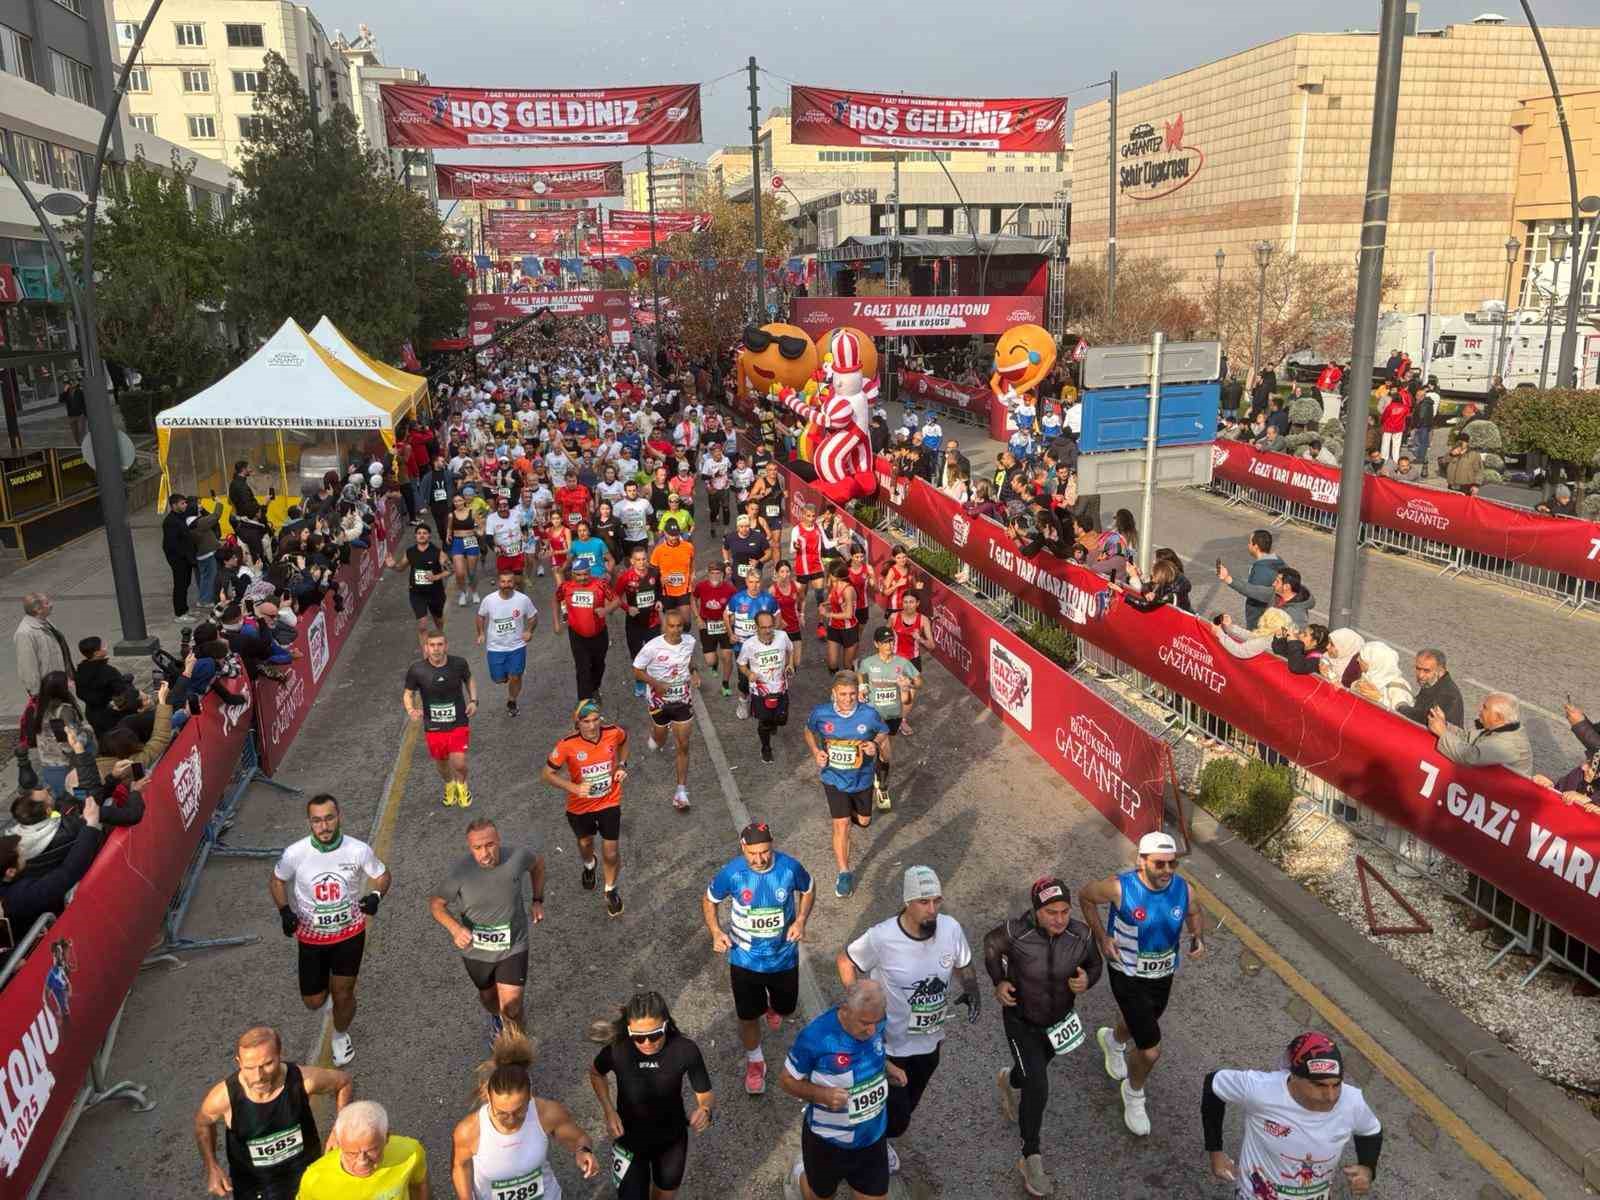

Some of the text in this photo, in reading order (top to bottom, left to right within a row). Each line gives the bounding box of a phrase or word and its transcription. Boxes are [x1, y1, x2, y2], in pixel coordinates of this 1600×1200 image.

[450, 99, 640, 132] HOŞ GELDİNİZ
[848, 104, 1013, 134] HOŞ GELDİNİZ
[1462, 338, 1484, 349] TRT
[1158, 644, 1227, 694] GAZİANTEP
[1055, 727, 1141, 820] GAZİANTEP
[314, 881, 341, 901] CR
[318, 910, 348, 925] 1845
[751, 915, 780, 929] 1065
[477, 932, 506, 943] 1502
[1054, 1018, 1080, 1047] 2015
[852, 1086, 885, 1111] 1989
[10, 1094, 39, 1151] 2025
[256, 1136, 298, 1157] 1685
